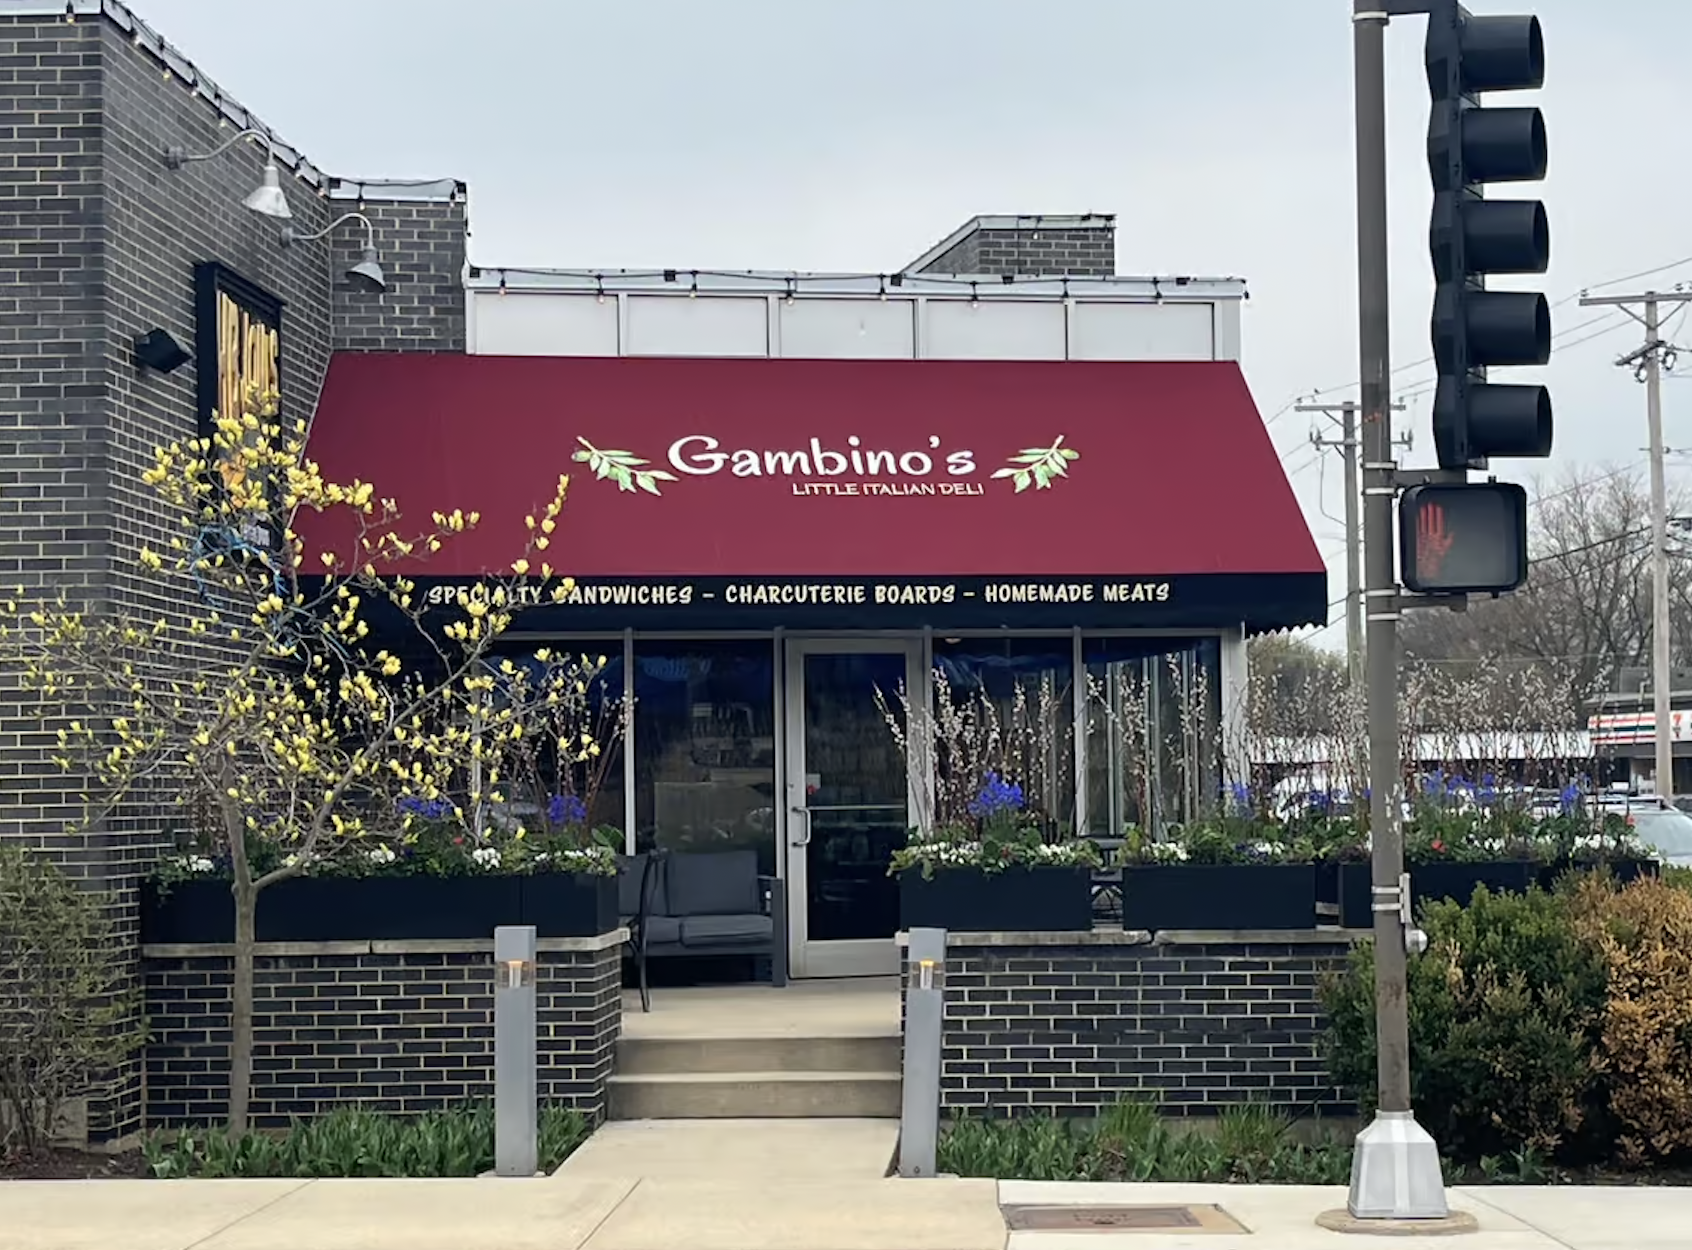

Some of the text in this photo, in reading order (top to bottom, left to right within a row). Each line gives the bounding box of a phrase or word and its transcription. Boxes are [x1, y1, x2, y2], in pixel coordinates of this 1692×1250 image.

[667, 434, 977, 477] Gambino's
[792, 482, 984, 496] LITTLE ITALIAN DELI
[549, 586, 693, 605] ANDWICHES
[725, 584, 866, 604] CHARCUTERIE
[874, 584, 955, 604] BOARDS
[985, 584, 1094, 603] HOMEMADE
[1103, 582, 1170, 602] MEATS
